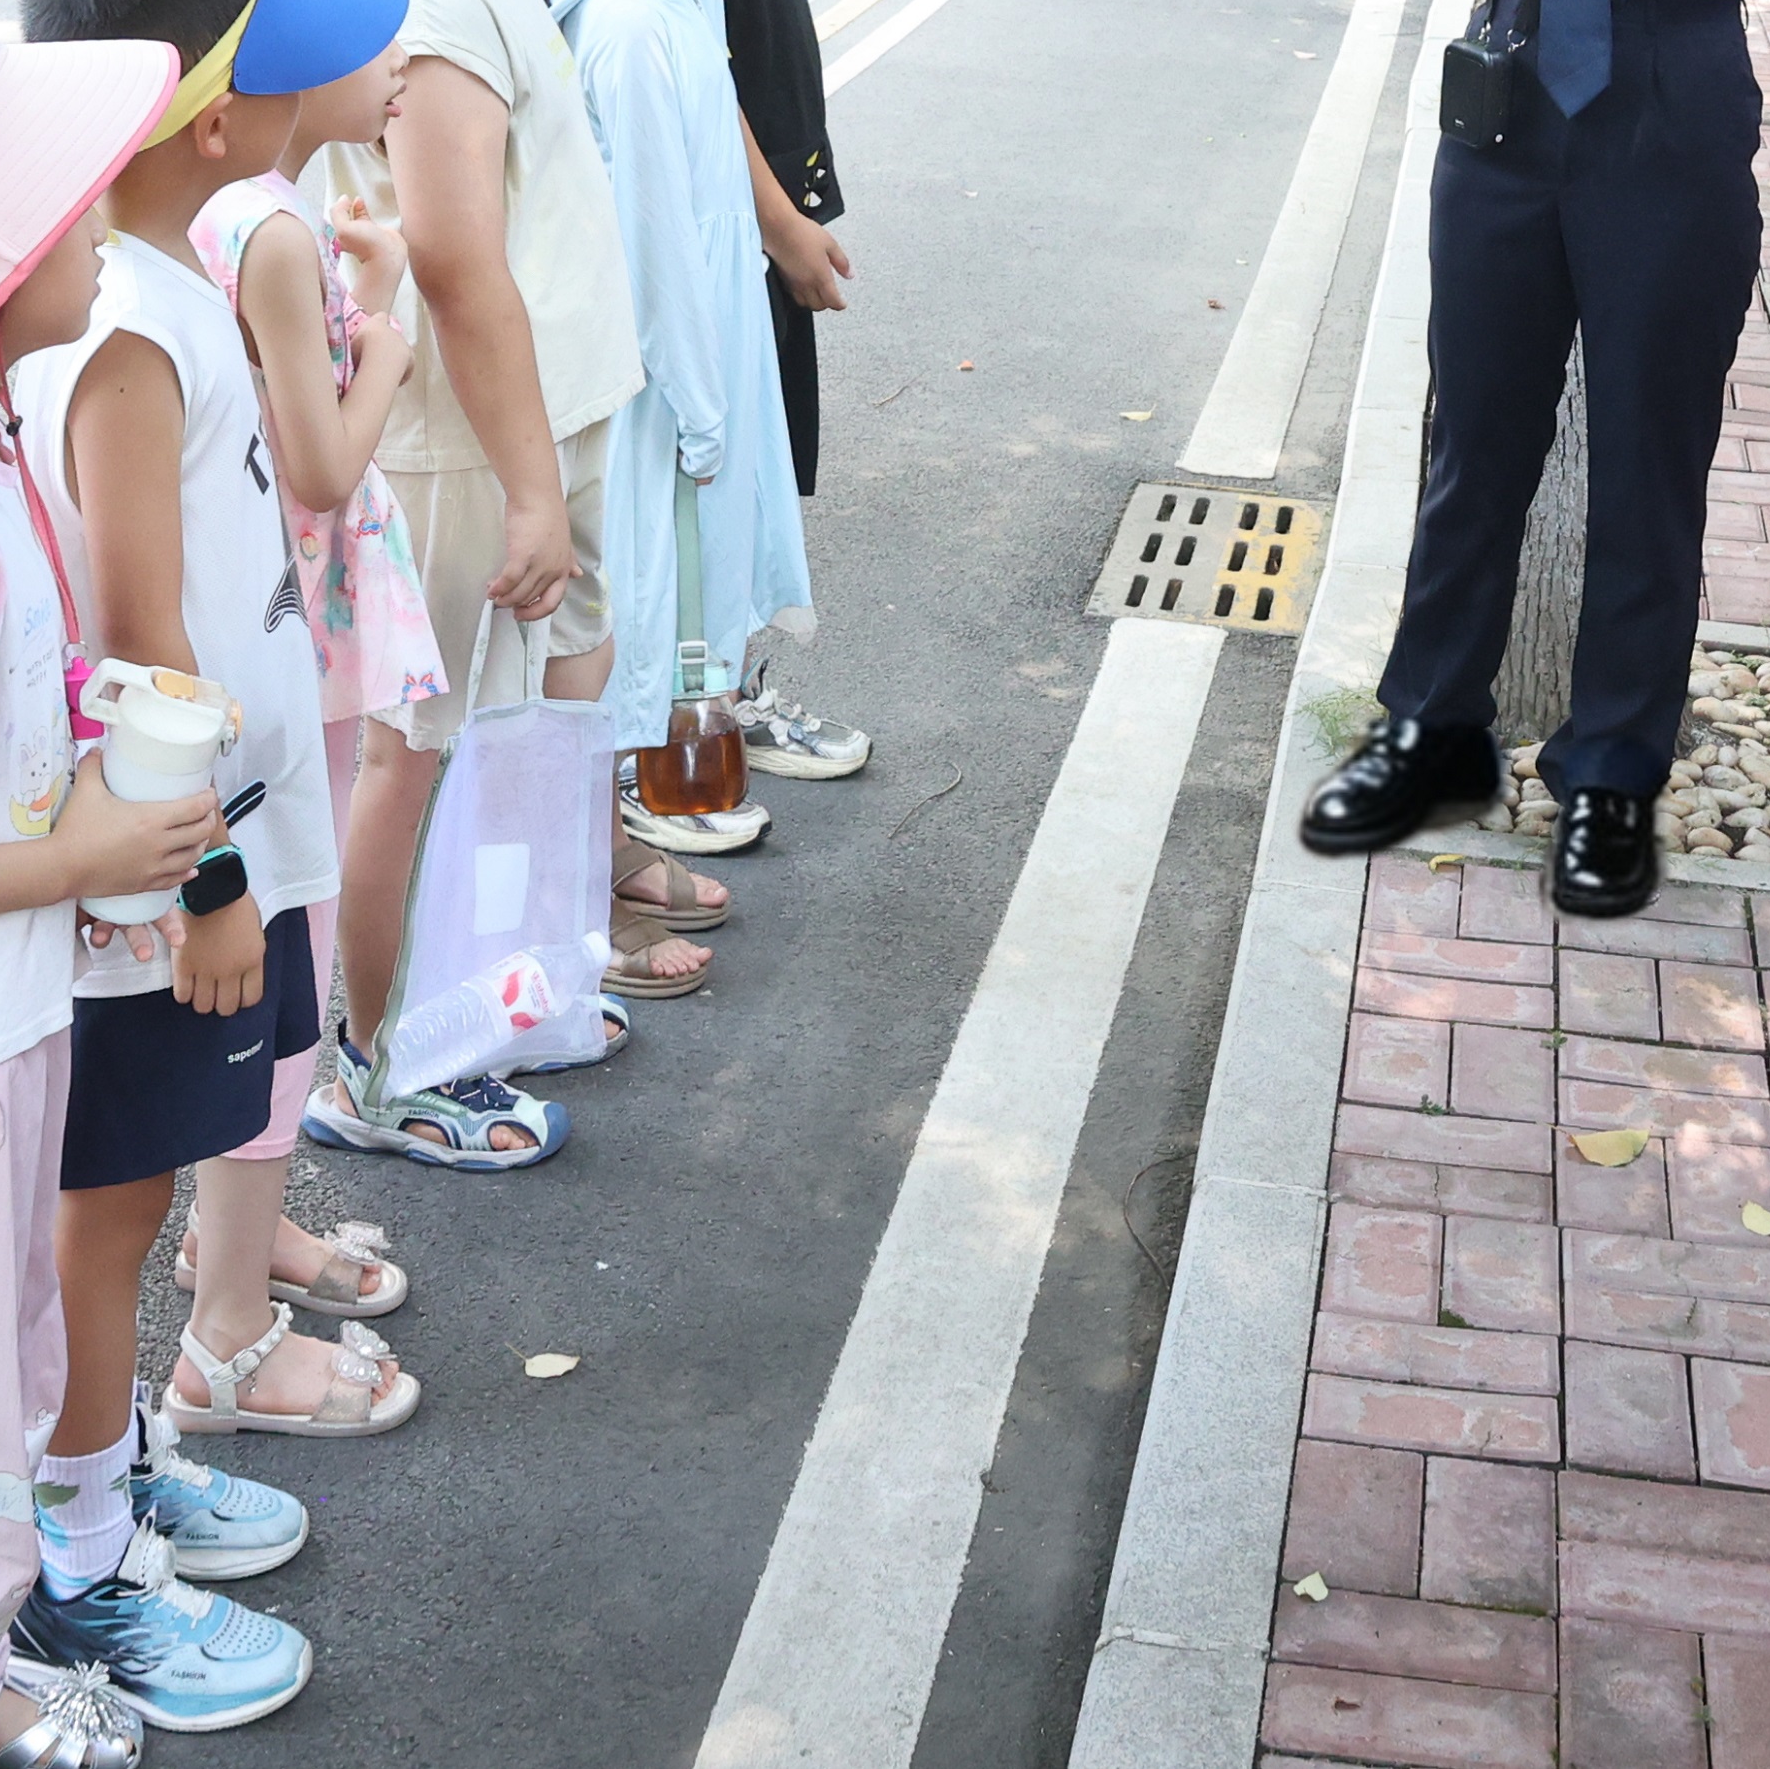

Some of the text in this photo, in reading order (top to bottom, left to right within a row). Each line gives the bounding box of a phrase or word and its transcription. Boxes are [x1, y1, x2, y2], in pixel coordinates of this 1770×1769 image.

[408, 1108, 440, 1120] FASHION
[185, 1532, 220, 1541] FASHION
[170, 1668, 207, 1681] FASHION
